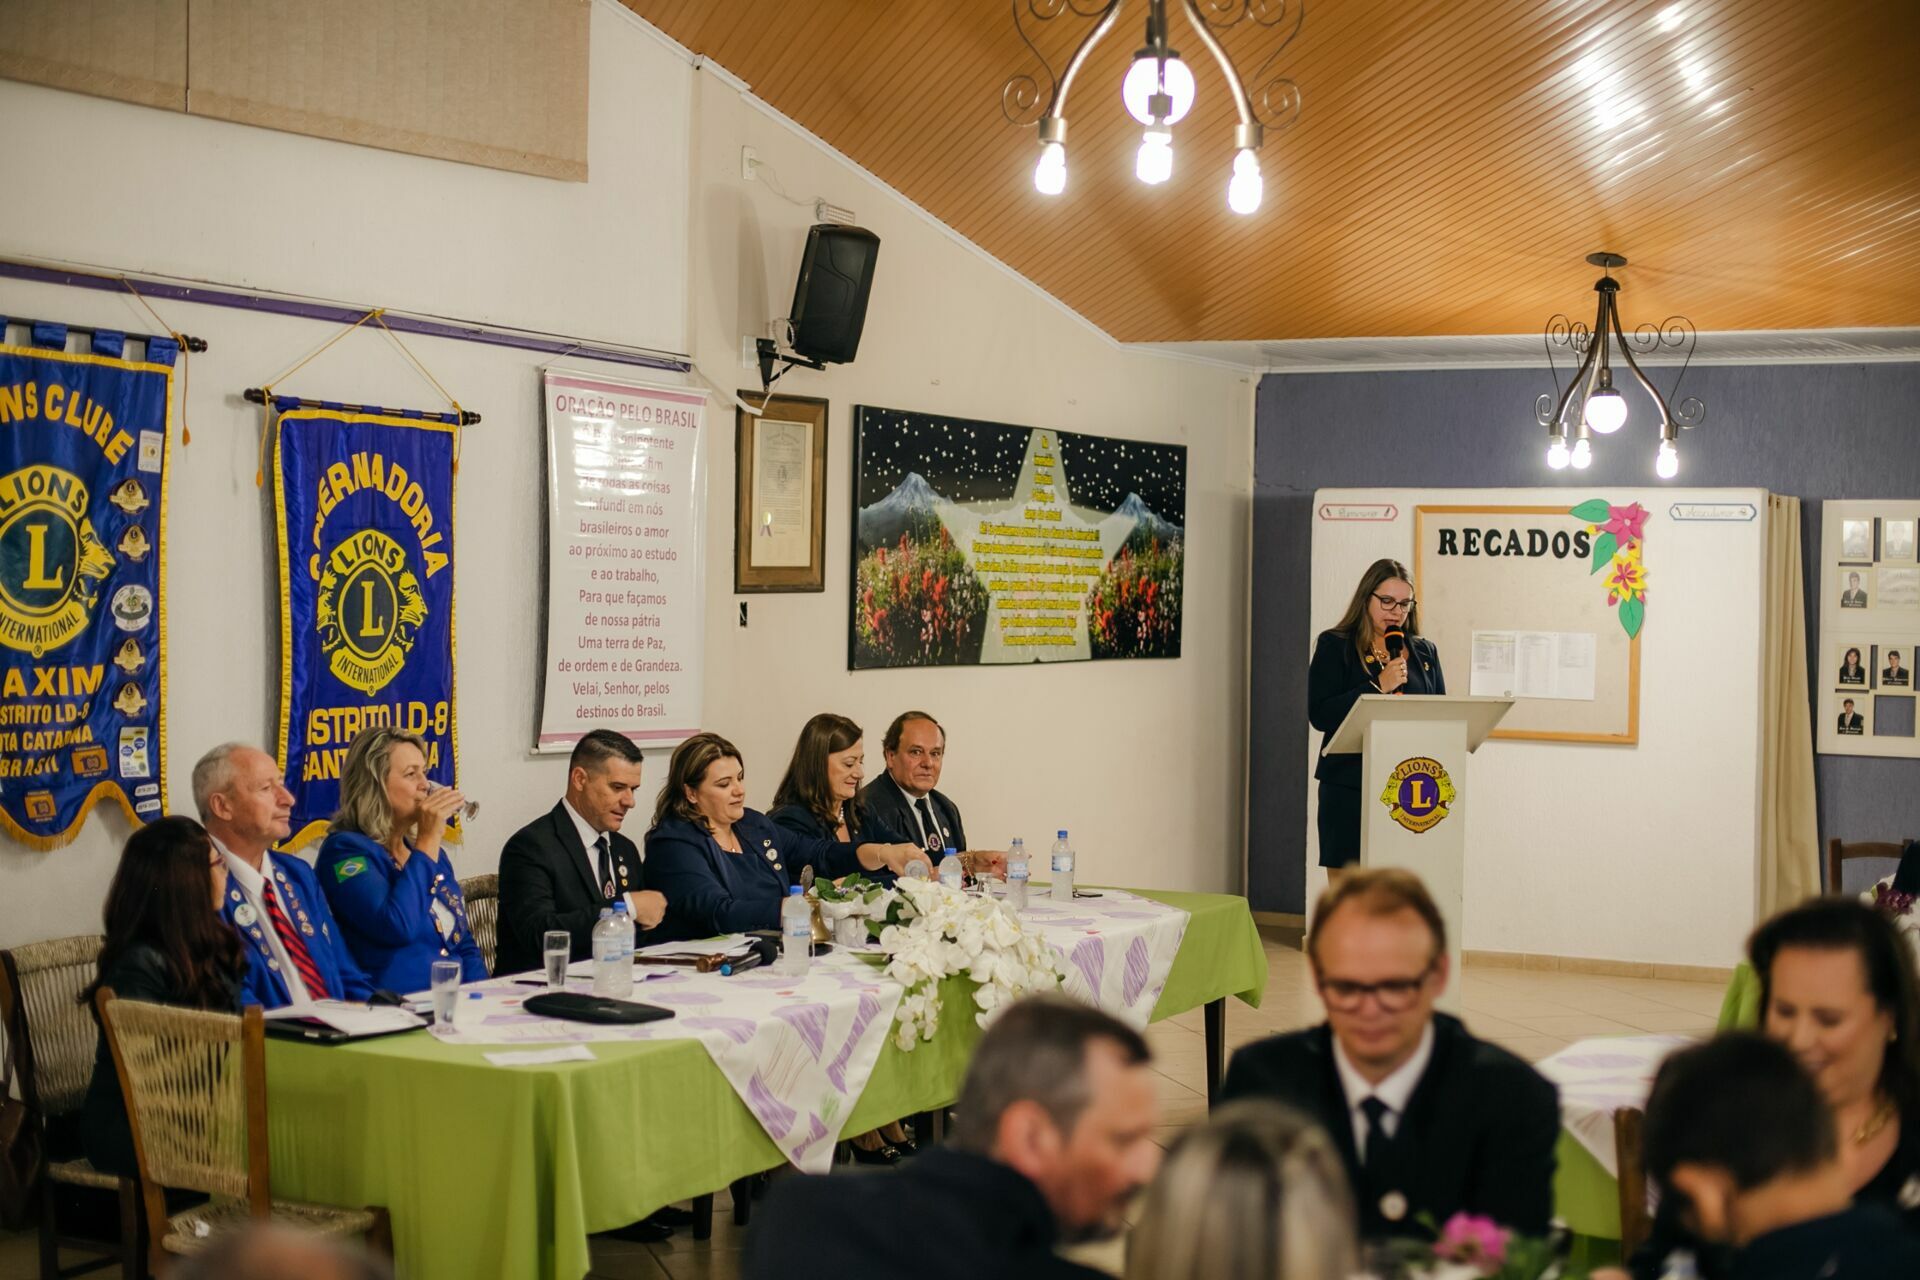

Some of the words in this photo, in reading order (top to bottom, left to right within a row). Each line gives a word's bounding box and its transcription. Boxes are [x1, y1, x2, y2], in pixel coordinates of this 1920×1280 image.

[556, 395, 615, 418] ORAÇÃO
[620, 403, 651, 423] PELO
[656, 407, 697, 429] BRASIL
[44, 383, 135, 466] CLUBE
[0, 470, 85, 513] LIONS
[641, 478, 671, 495] coisas
[628, 503, 644, 514] em
[646, 502, 664, 516] nós
[580, 519, 633, 536] brasileiros
[635, 527, 642, 537] o
[644, 528, 670, 538] amor
[337, 533, 401, 570] LIONS
[569, 545, 582, 556] ao
[585, 543, 628, 559] próximo
[630, 548, 643, 559] ao
[645, 548, 677, 562] estudo
[1437, 528, 1591, 559] RECADOS
[23, 525, 63, 589] L
[591, 570, 598, 580] e
[600, 570, 613, 581] ao
[615, 568, 660, 584] trabalho,
[579, 589, 602, 603] Para
[605, 593, 624, 606] que
[626, 591, 667, 607] façamos
[359, 580, 385, 637] L
[584, 612, 598, 626] de
[600, 615, 630, 627] nossa
[632, 613, 660, 629] pátria
[578, 636, 602, 649] Uma
[606, 637, 629, 649] terra
[632, 637, 644, 649] de
[647, 637, 666, 651] Paz,
[336, 653, 399, 684] INTERNATIONAL
[558, 658, 571, 672] de
[574, 659, 609, 672] ordem
[611, 662, 618, 672] e
[620, 659, 633, 672] de
[635, 659, 683, 672] Grandeza.
[573, 682, 602, 697] Velai,
[604, 681, 642, 696] Senhor,
[644, 681, 670, 697] pelos
[55, 702, 90, 723] LD-8
[576, 704, 619, 719] destinos
[621, 704, 634, 717] do
[637, 704, 667, 717] Brasil.
[0, 754, 59, 777] BRASIL
[1401, 761, 1438, 777] LIONS
[1410, 780, 1431, 809] L
[1400, 814, 1440, 827] INTERNATIONAL
